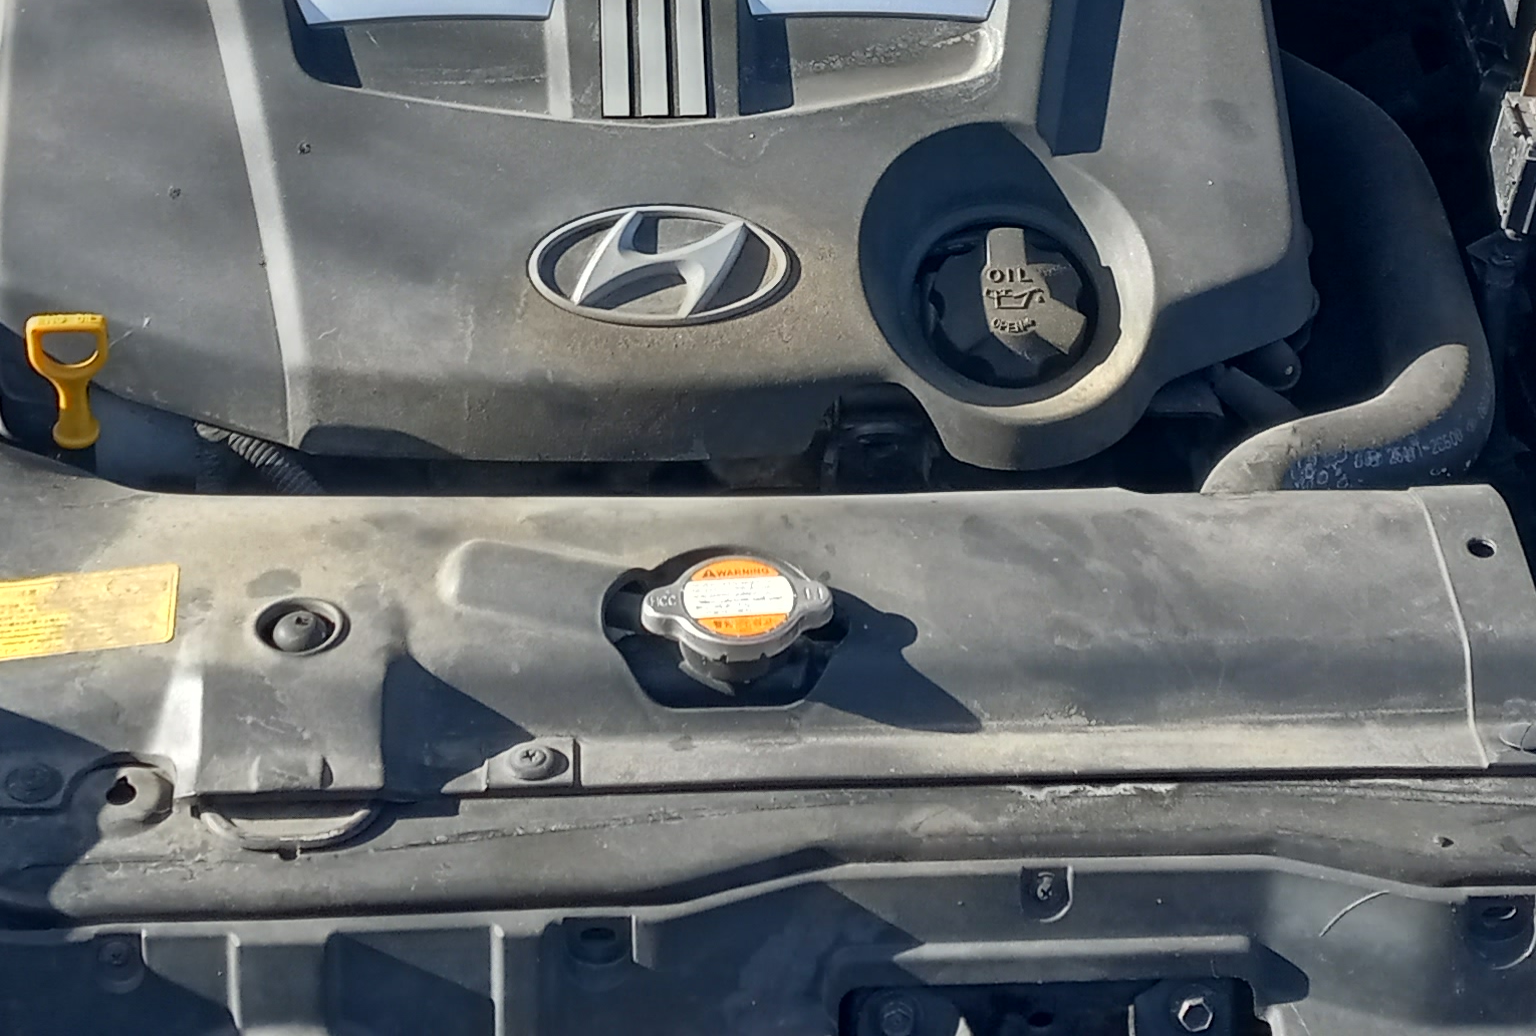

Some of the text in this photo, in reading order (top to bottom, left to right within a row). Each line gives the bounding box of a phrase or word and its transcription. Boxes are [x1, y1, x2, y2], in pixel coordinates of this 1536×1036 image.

[987, 267, 1034, 284] OIL
[990, 316, 1026, 333] OPEN
[716, 567, 770, 578] WARNING
